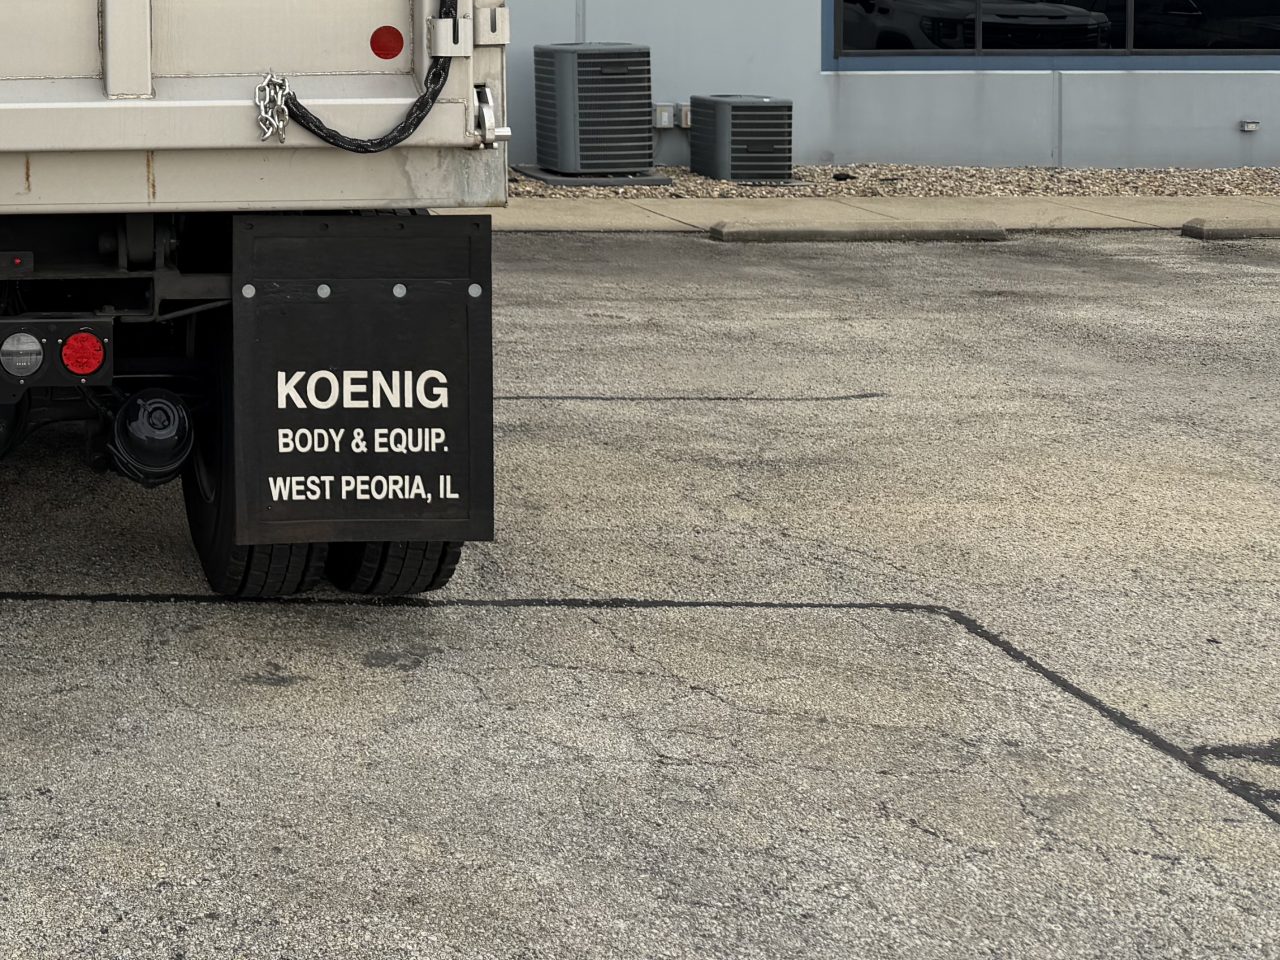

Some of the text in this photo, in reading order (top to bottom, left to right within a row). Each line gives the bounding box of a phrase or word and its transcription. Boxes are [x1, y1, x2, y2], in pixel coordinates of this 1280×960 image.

[277, 369, 449, 410] KOENIG
[278, 427, 449, 454] BODY & EQUIP.
[268, 475, 460, 504] WEST PEORIA, IL
